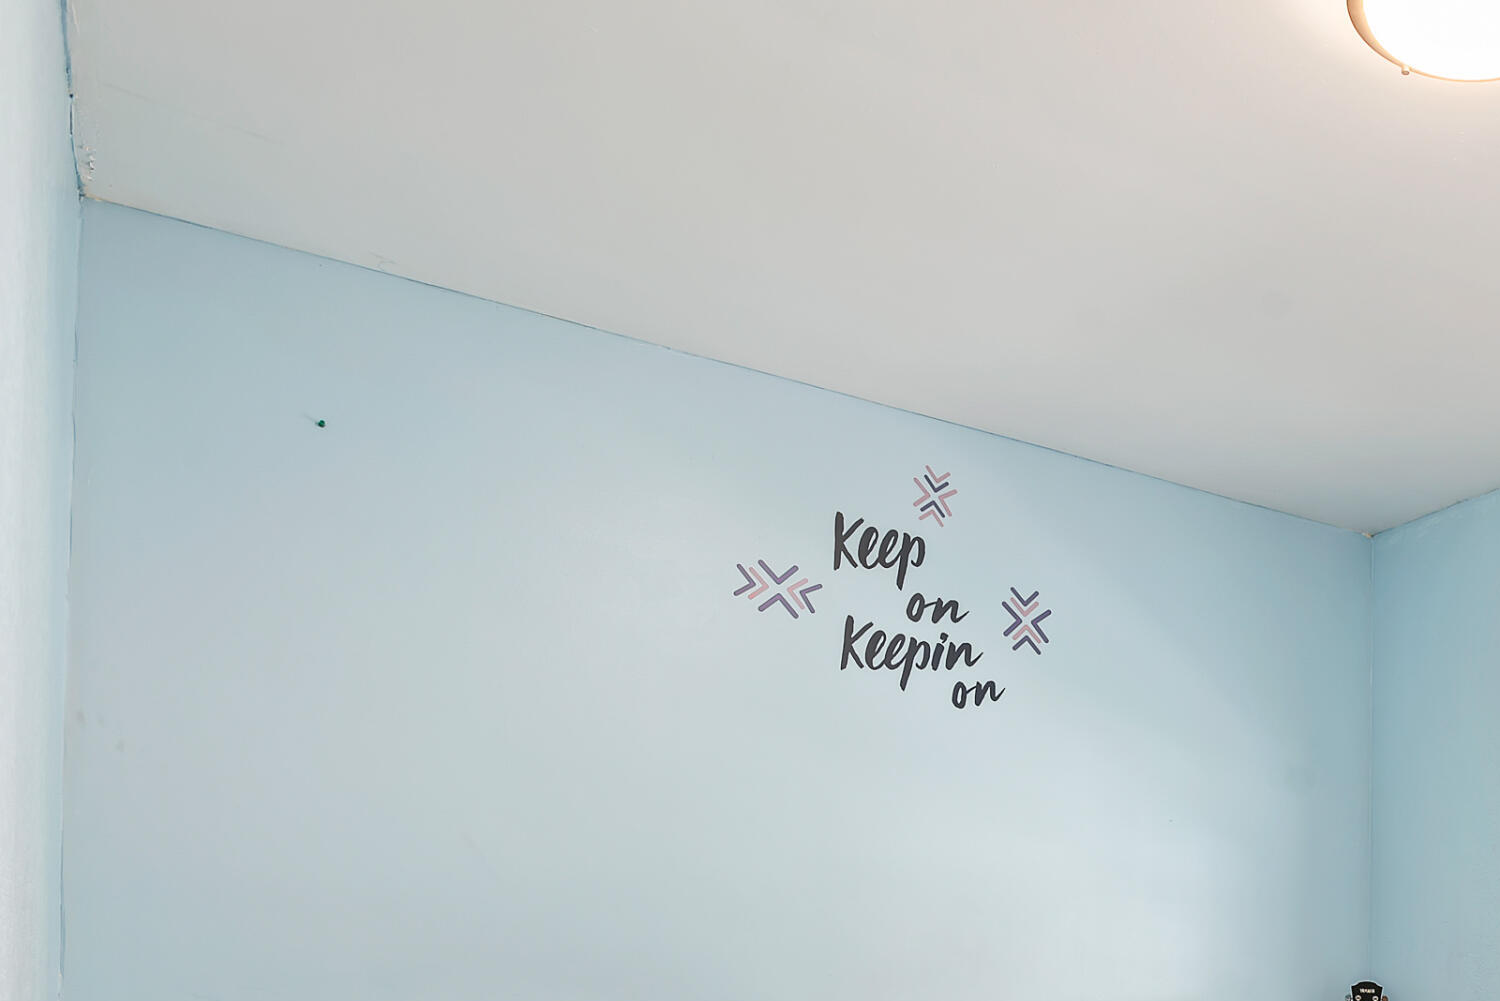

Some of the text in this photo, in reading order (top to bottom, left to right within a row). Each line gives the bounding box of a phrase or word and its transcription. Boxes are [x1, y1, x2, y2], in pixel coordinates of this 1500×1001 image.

[833, 511, 926, 591] Keep
[906, 592, 970, 624] on
[840, 615, 984, 692] Keepin
[951, 680, 1006, 709] on
